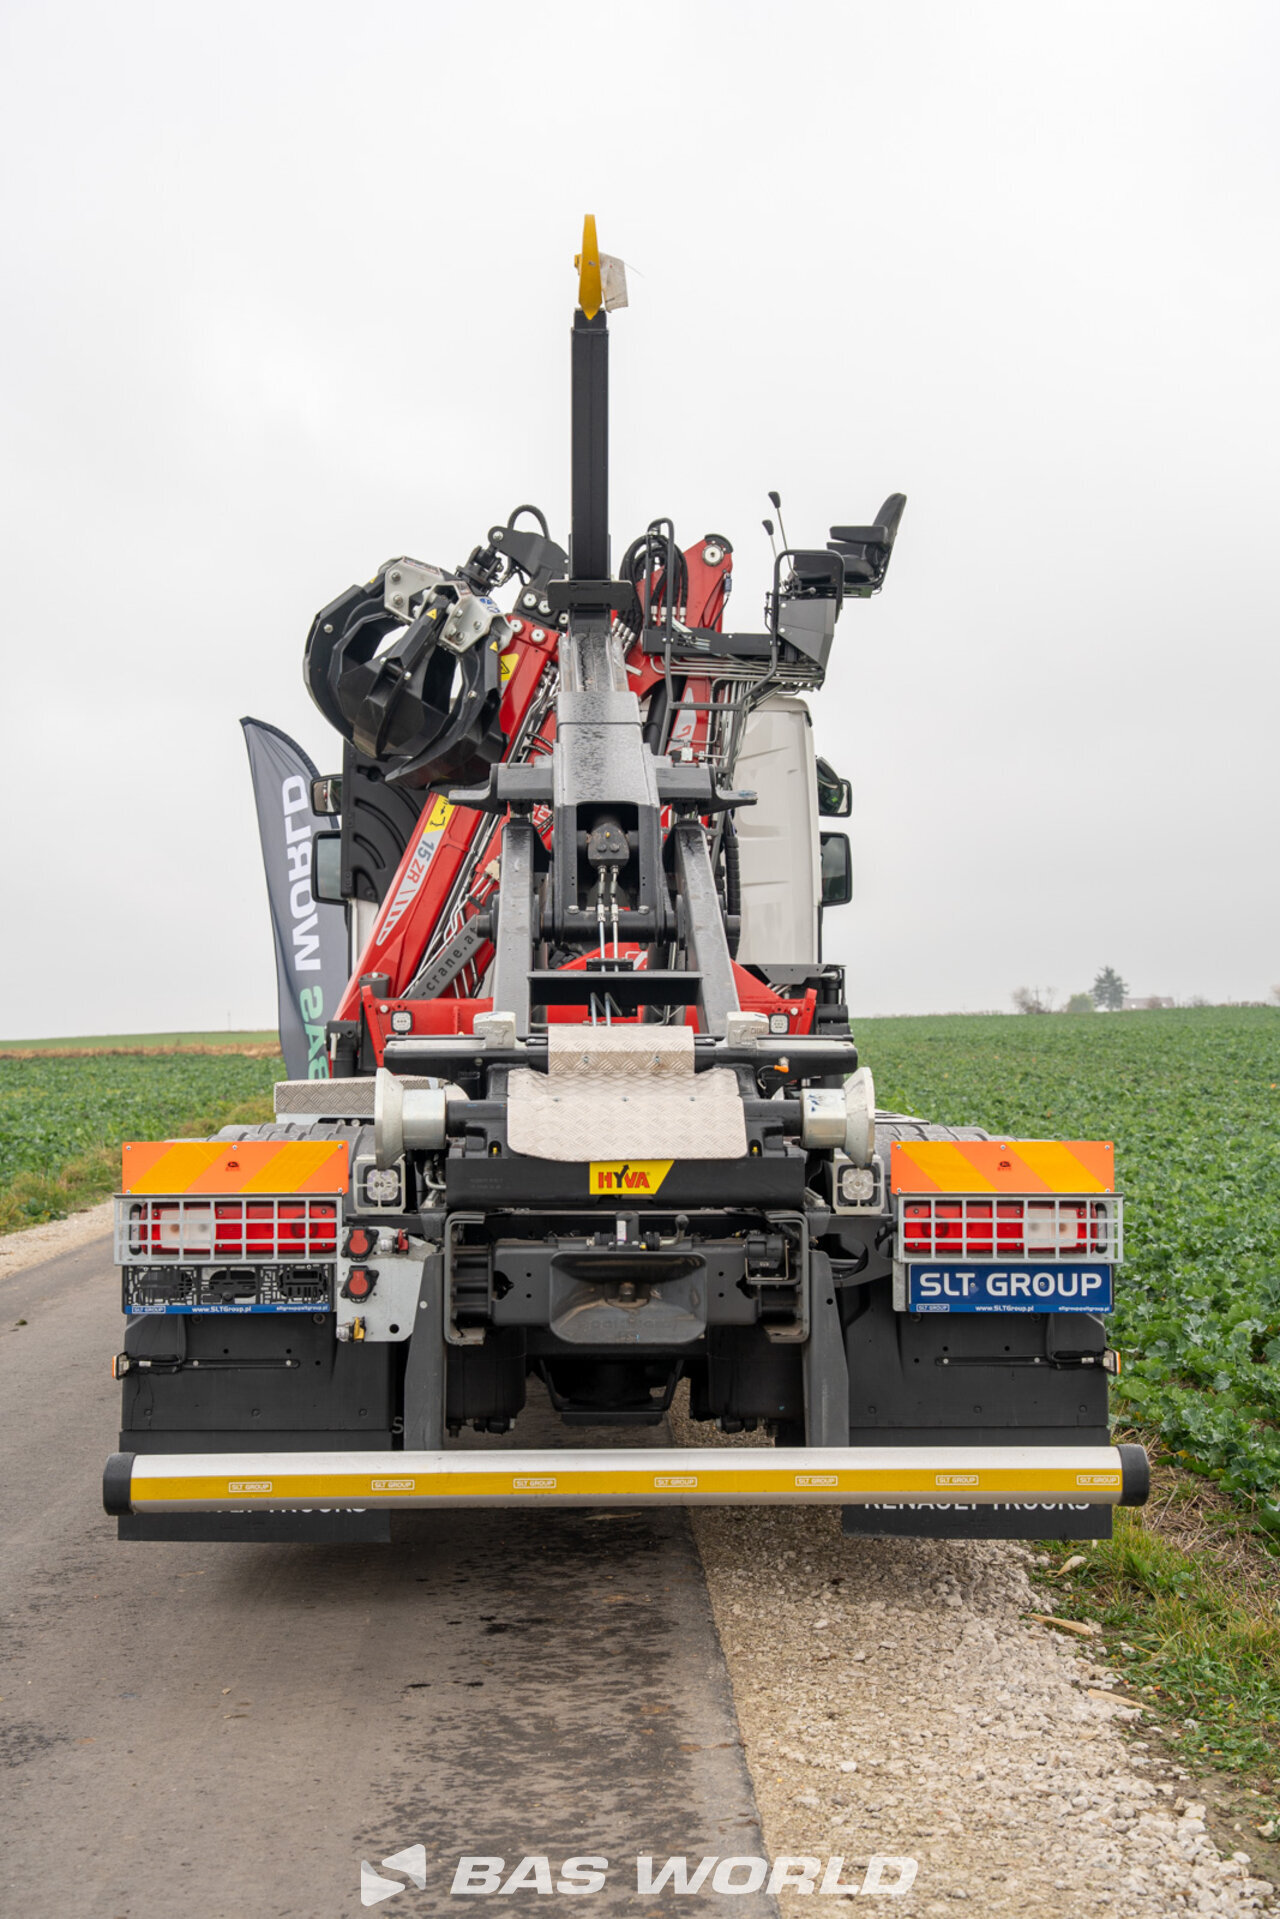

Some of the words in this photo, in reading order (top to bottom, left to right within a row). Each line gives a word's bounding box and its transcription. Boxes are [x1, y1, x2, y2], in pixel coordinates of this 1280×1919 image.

[598, 1164, 650, 1188] HYVA
[919, 1273, 976, 1297] SLT
[986, 1273, 1102, 1297] GROUP
[192, 1305, 252, 1313] www.SLTGroup.pl
[975, 1304, 1034, 1312] www.SLTGroup.pl
